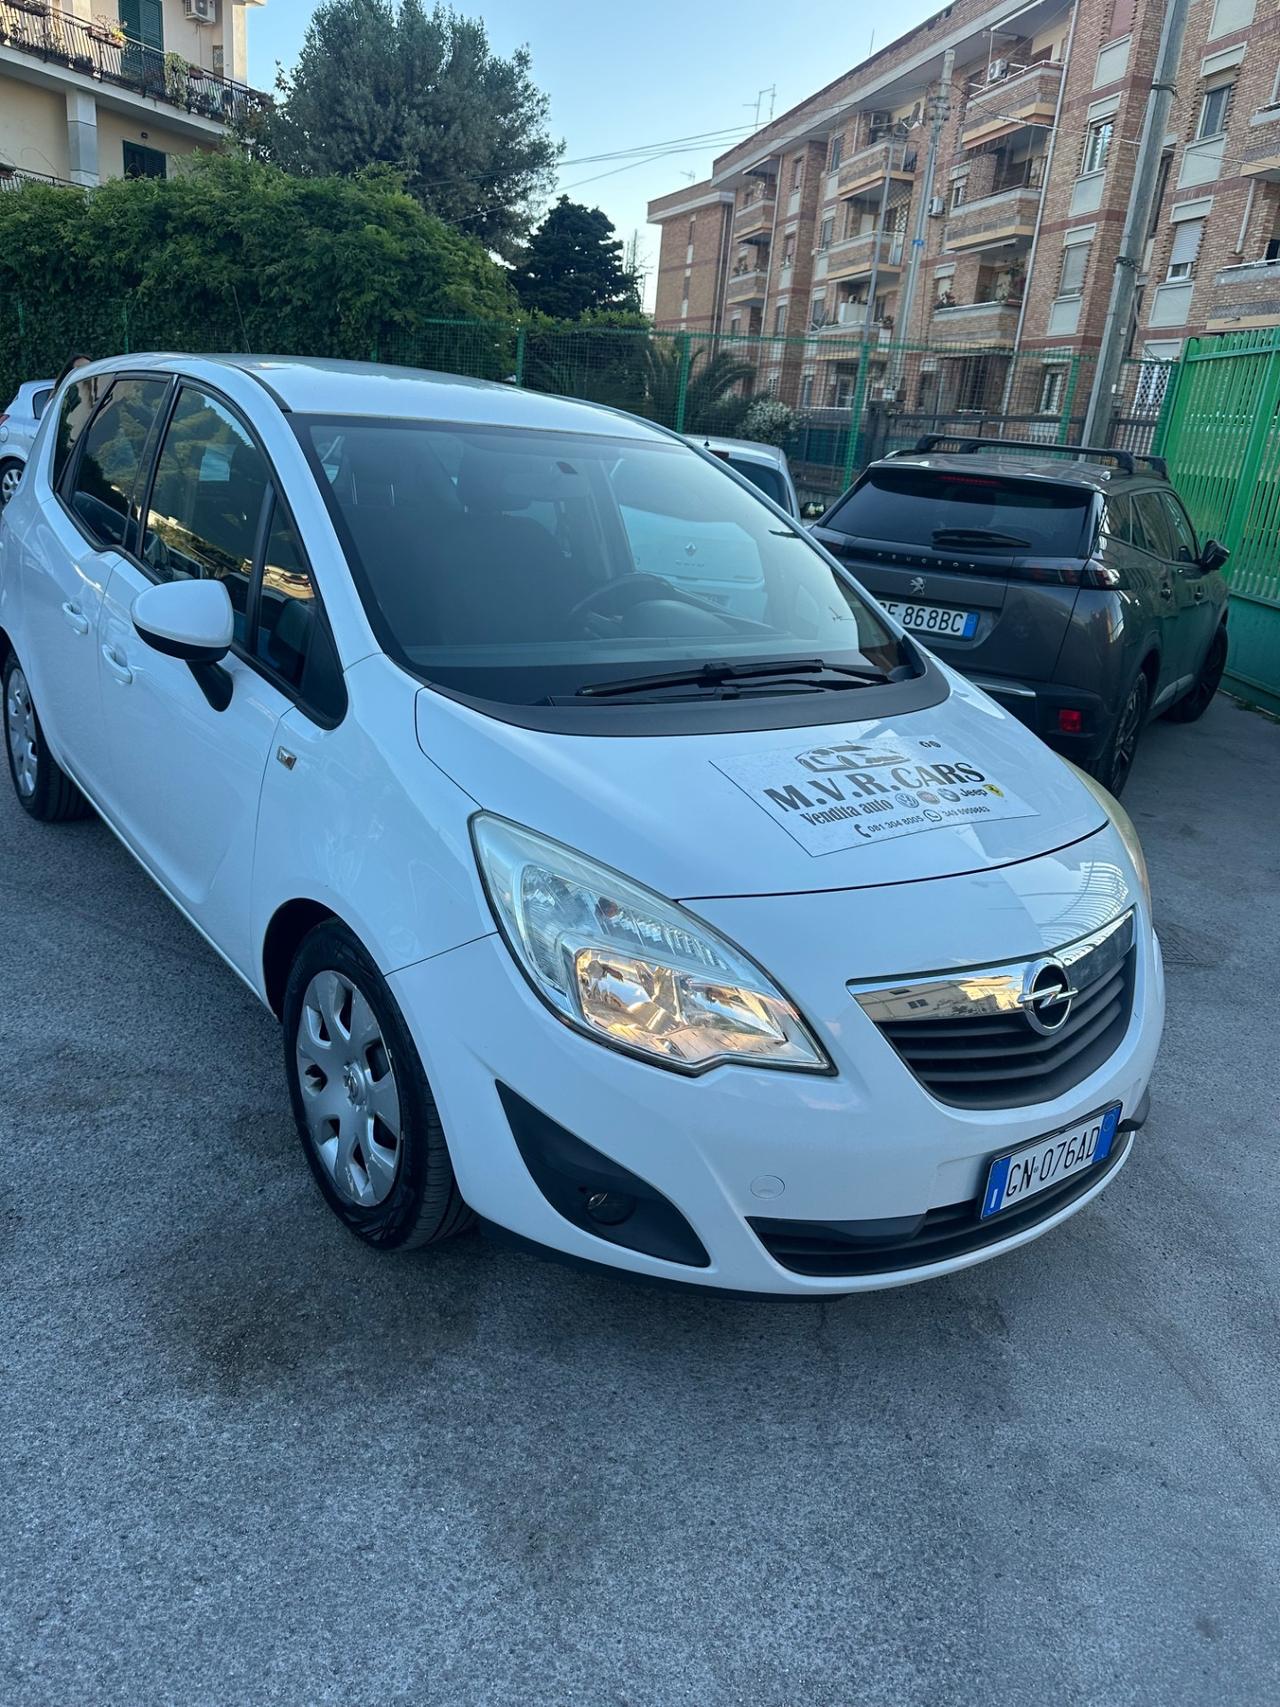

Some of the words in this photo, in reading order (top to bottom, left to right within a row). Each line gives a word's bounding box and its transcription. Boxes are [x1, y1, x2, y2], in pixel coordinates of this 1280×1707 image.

[877, 552, 976, 569] PEUGEOT
[800, 805, 862, 826] Vendita
[858, 799, 894, 814] auto
